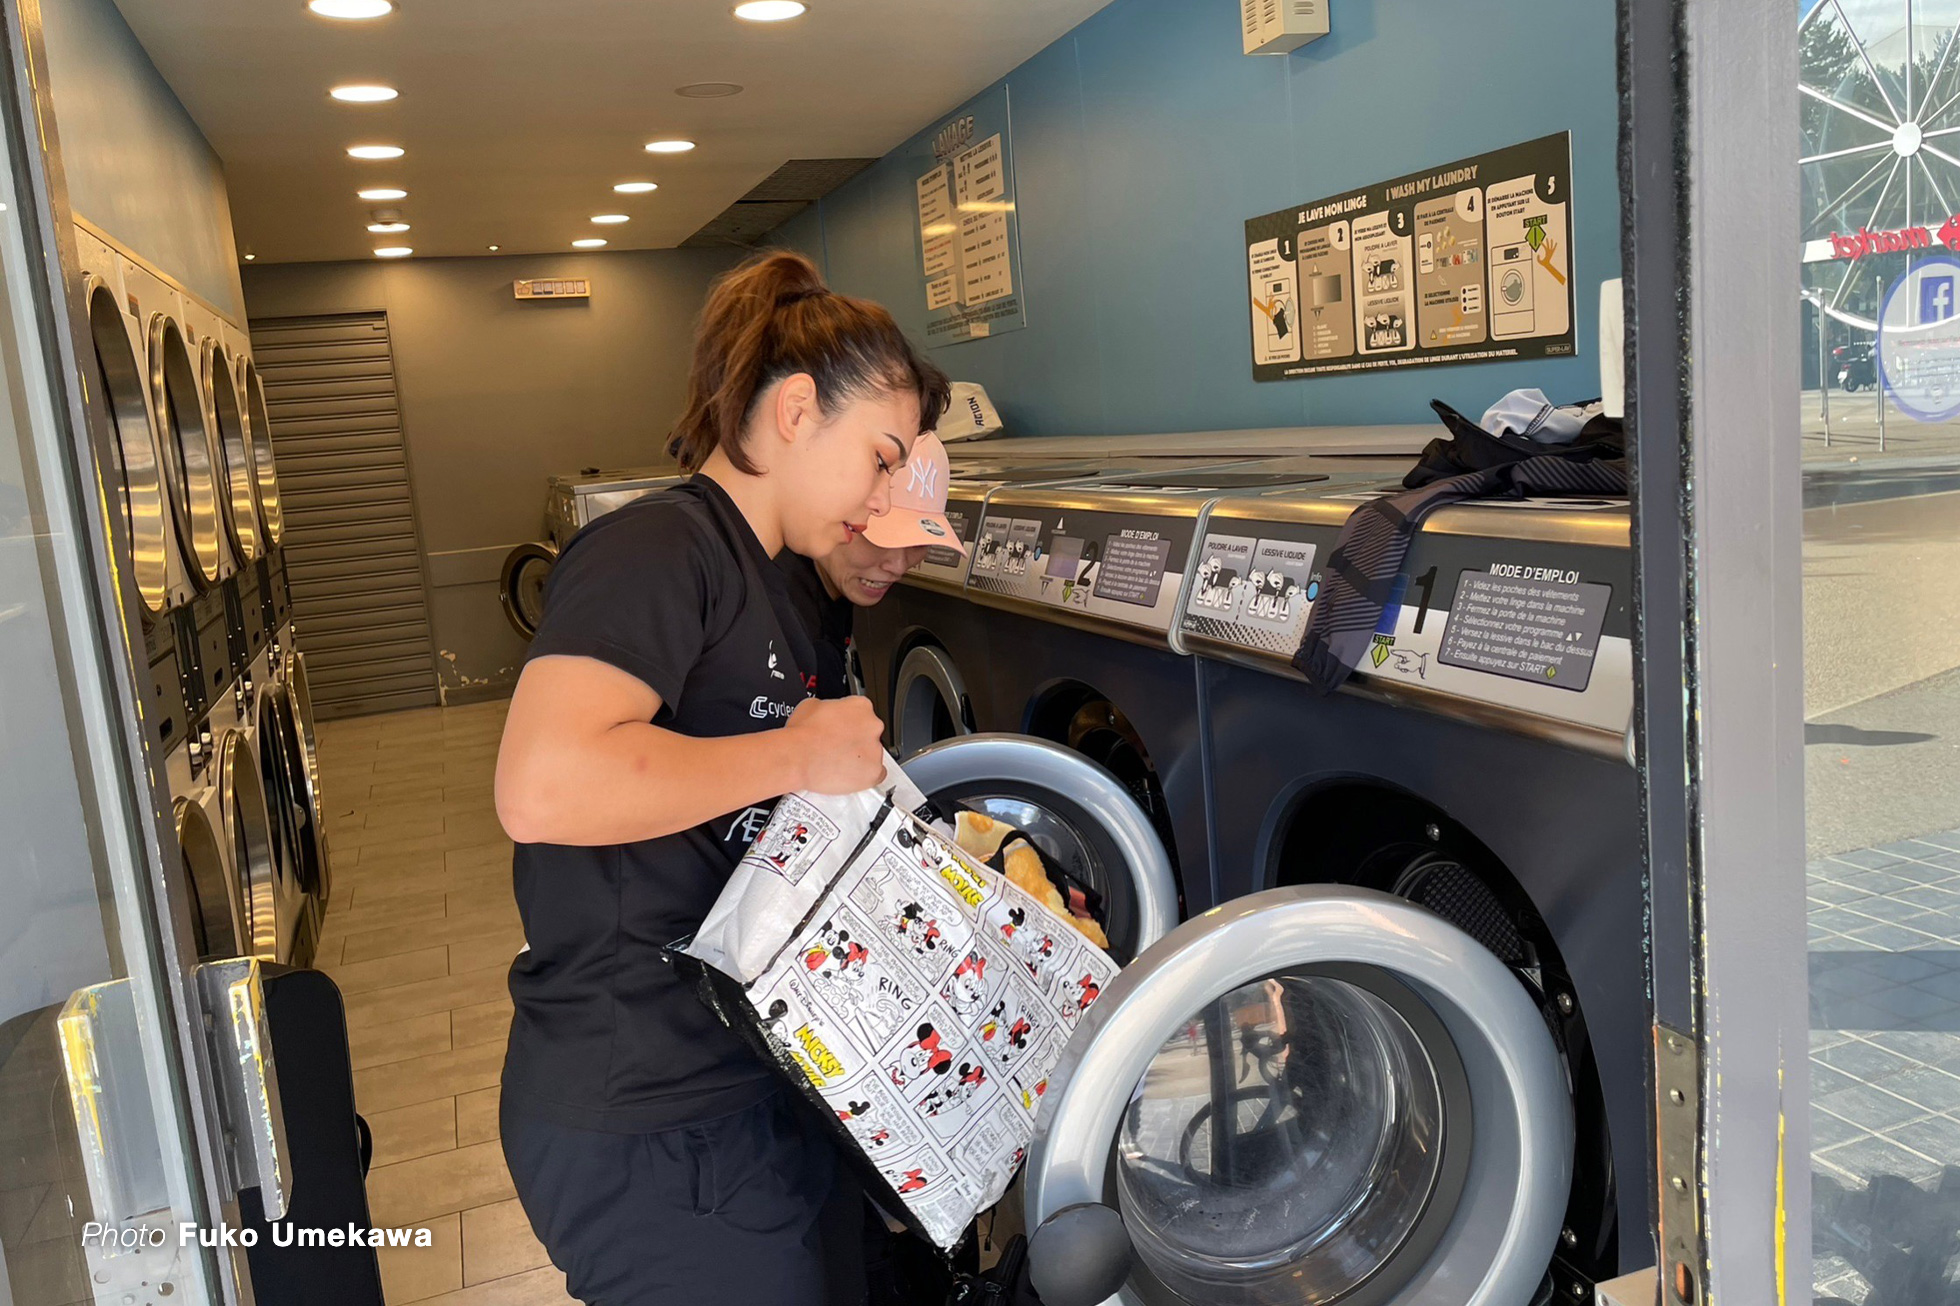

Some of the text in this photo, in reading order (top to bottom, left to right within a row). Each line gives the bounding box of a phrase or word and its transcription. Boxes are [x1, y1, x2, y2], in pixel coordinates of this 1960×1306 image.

[1386, 165, 1478, 201] I WASH MY LAUNDRY
[1547, 175, 1555, 195] 5
[1298, 195, 1367, 224] JE LAVE MON LINGE
[1467, 195, 1475, 212] 4
[1397, 212, 1404, 229] 3
[1525, 216, 1546, 227] START
[1337, 227, 1344, 242] 2
[1284, 240, 1291, 255] 1
[907, 456, 938, 499] NY
[1207, 541, 1227, 551] POUDRE
[1231, 545, 1249, 554] LAVER
[1262, 547, 1307, 561] LESSIVE LIQUIDE
[1077, 541, 1099, 587] 2
[1489, 563, 1580, 585] MODE D'EMPLOI
[1415, 565, 1438, 634] 1
[1463, 579, 1579, 600] 1 Videz les poches des vêtements
[1456, 602, 1462, 610] 3
[1465, 604, 1490, 614] Fermez
[1497, 609, 1516, 619] porte
[1516, 611, 1526, 619] de
[1527, 612, 1534, 620] la
[1534, 614, 1566, 624] machine
[1469, 592, 1491, 602] Mettez
[1491, 596, 1508, 604] votre
[1508, 597, 1526, 609] linge
[1526, 599, 1544, 609] dans
[1545, 602, 1552, 610] la
[1553, 603, 1585, 615] machine
[1463, 616, 1504, 628] Sélectionnez
[1504, 622, 1521, 631] votre
[1521, 626, 1563, 639] programme
[1374, 635, 1395, 646] START
[1450, 625, 1593, 656] 5 Versez la lessive dans le bac du dessus
[1456, 638, 1476, 651] Payez
[1478, 641, 1483, 649] à
[1484, 643, 1490, 651] la
[1490, 645, 1517, 655] centrale
[1518, 649, 1527, 658] de
[1527, 652, 1562, 664] paiement
[1444, 647, 1545, 674] 7 Ensuite appuyez sur START
[940, 865, 983, 908] MOUSE
[938, 940, 962, 959] RING
[879, 977, 912, 1010] RING
[1018, 1004, 1042, 1031] RING!
[793, 1022, 846, 1078] MICKEY
